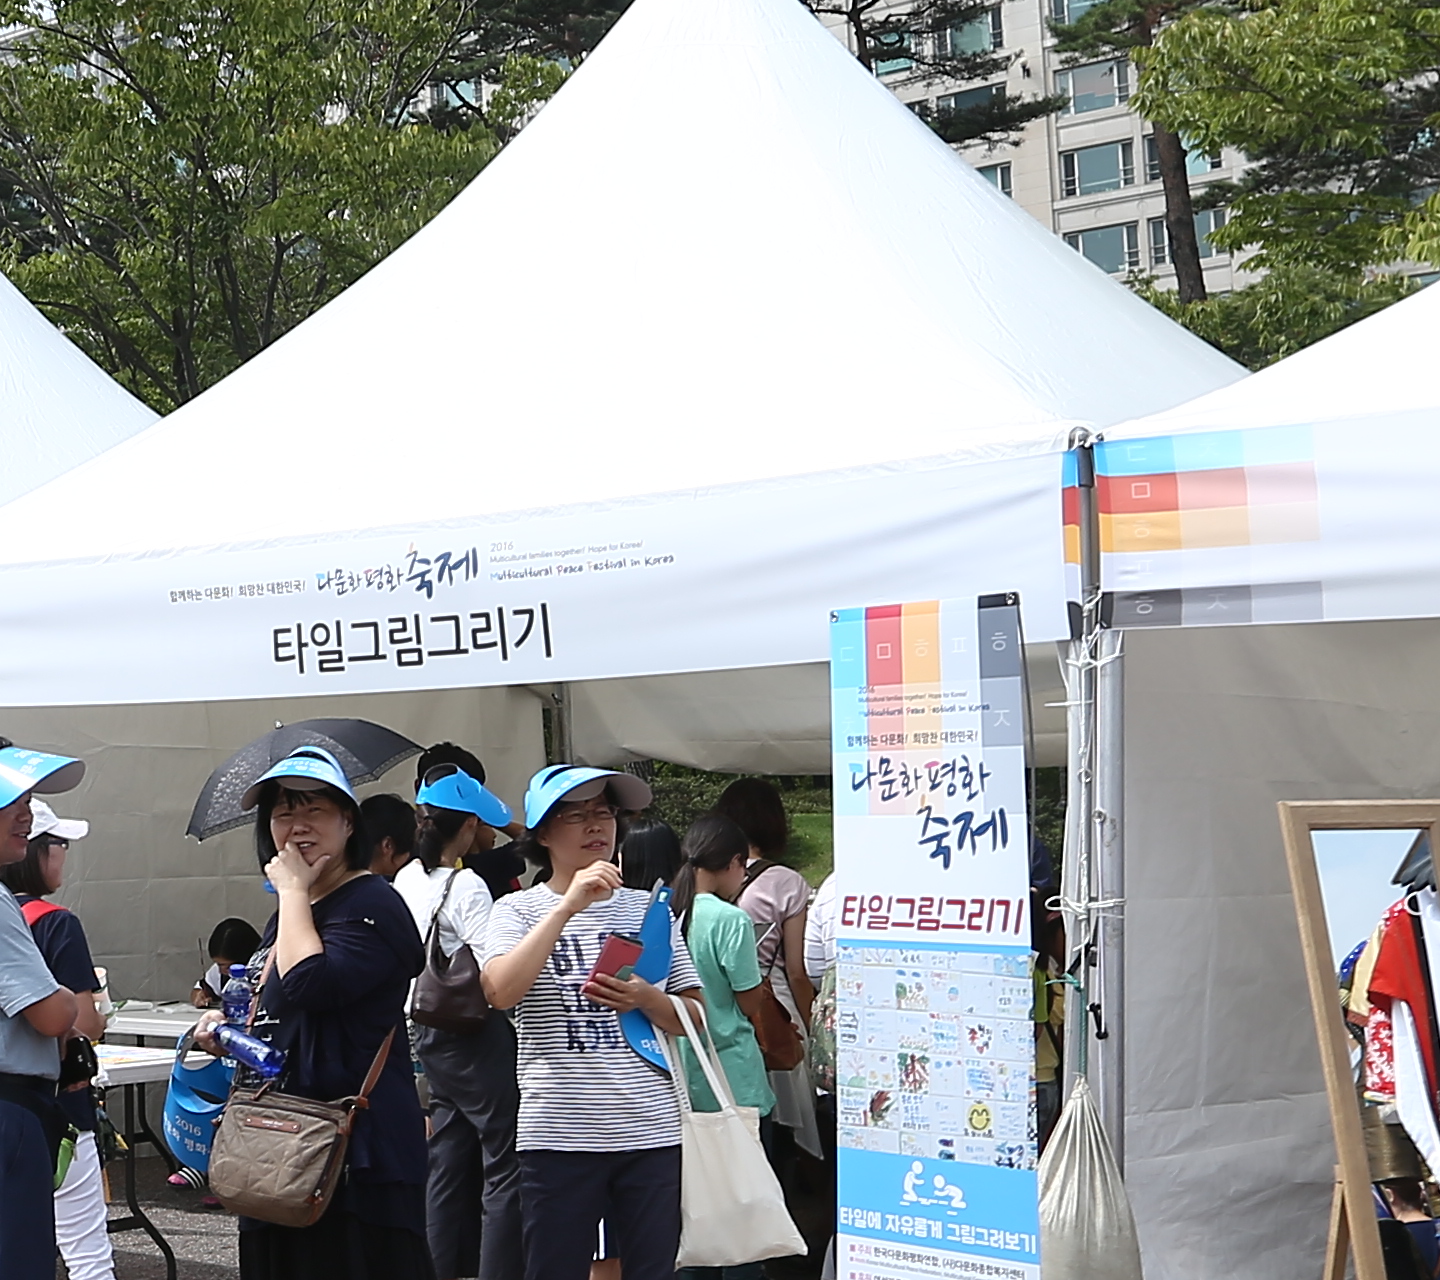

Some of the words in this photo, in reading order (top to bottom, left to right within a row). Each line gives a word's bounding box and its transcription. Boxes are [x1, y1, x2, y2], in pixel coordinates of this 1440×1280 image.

[489, 541, 514, 553] 2016
[405, 542, 478, 599] 축제
[490, 564, 553, 582] Multicultural
[557, 564, 584, 576] Peace
[587, 557, 627, 572] Festival
[630, 558, 641, 567] in
[645, 554, 675, 567] Korea
[169, 589, 202, 602] 함께하는
[205, 586, 234, 599] 다문화!
[238, 583, 265, 596] 희망찬
[267, 580, 306, 595] 대한민국!
[271, 603, 553, 675] 타일그림그리기
[847, 735, 878, 747] 함께하는
[880, 733, 908, 746] 다문화!
[912, 732, 938, 745] 희망찬
[940, 730, 979, 744] 대한민국!
[916, 794, 1009, 870] 축제
[840, 894, 1025, 936] 타일그림그리기
[175, 1115, 202, 1137] 2016
[839, 1207, 881, 1230] 타일에
[885, 1214, 943, 1240] 자유롭게
[947, 1223, 1037, 1254] 그림그려보기
